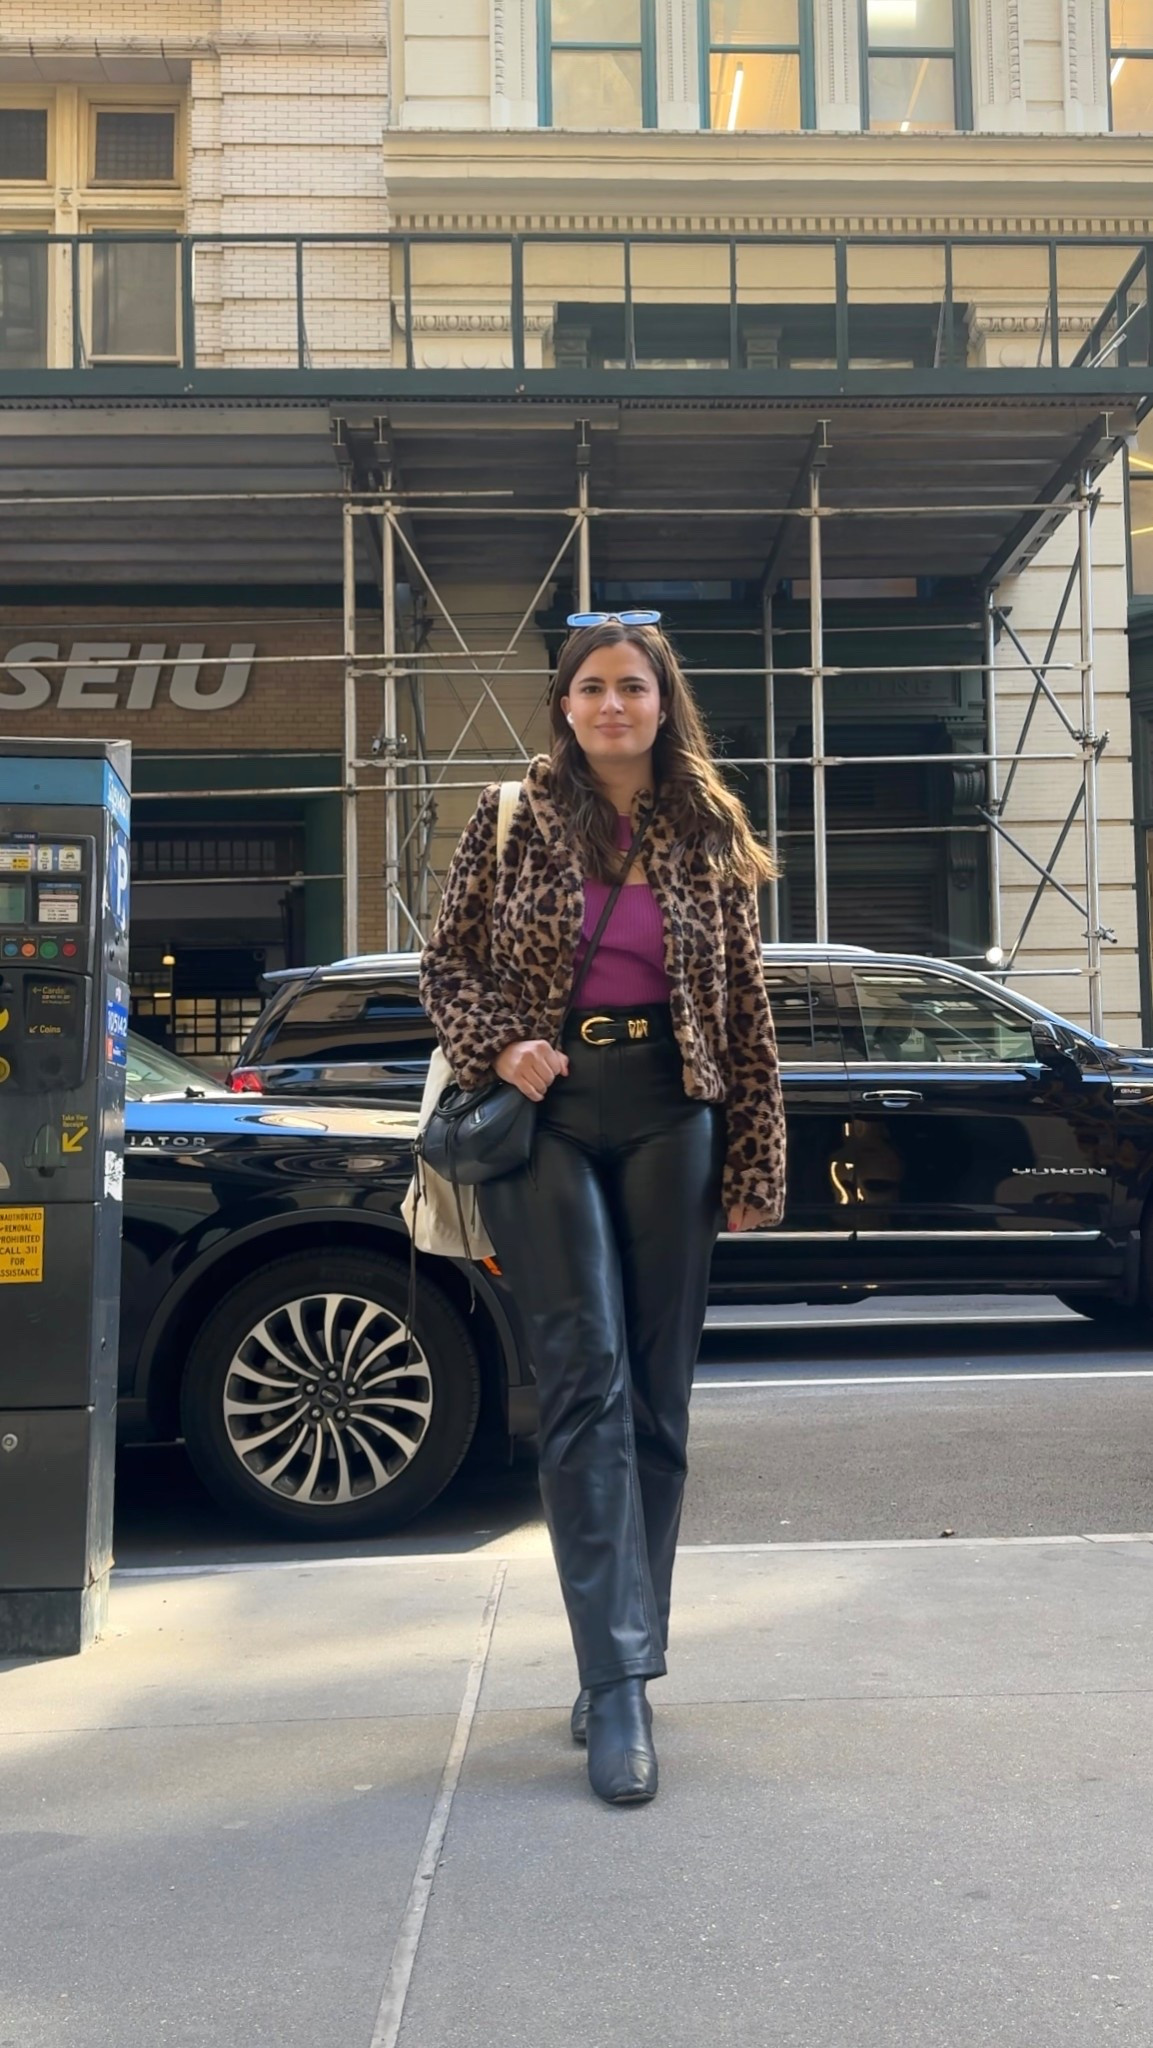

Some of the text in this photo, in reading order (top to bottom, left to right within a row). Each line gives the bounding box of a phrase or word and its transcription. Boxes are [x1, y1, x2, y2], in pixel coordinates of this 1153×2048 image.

[0, 641, 257, 711] SEIU
[39, 1024, 62, 1034] Coins
[130, 1136, 206, 1146] IATOR
[1012, 1167, 1107, 1176] YUKON
[0, 1213, 42, 1221] NAUTHORIZED
[5, 1224, 32, 1232] REMOVAL
[0, 1235, 40, 1243] ROHIBITED
[0, 1246, 38, 1255] CALL 311
[10, 1257, 25, 1266] FOR
[0, 1268, 39, 1277] SSISTANCE
